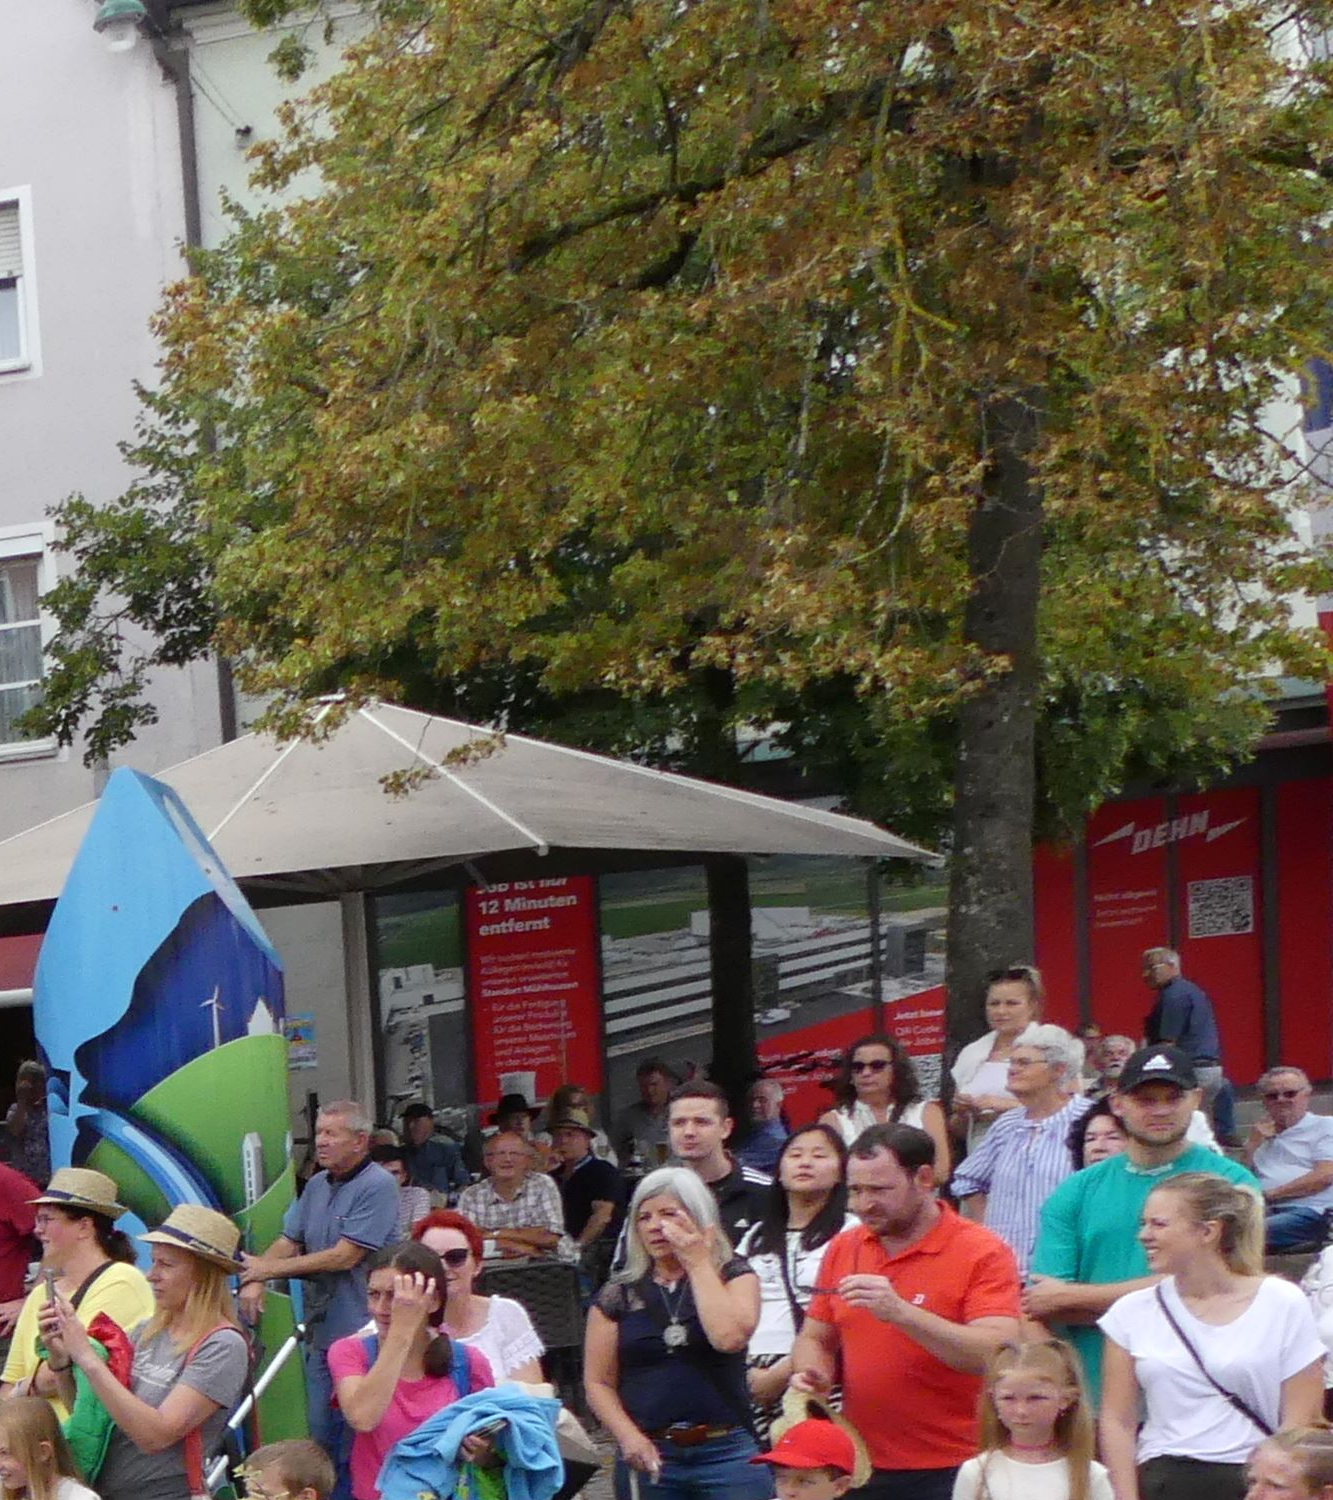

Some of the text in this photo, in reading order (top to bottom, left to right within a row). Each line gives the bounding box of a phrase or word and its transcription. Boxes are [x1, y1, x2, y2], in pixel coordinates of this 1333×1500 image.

[1131, 810, 1210, 855] DEHN
[478, 894, 578, 915] 12 Minuten
[478, 916, 551, 936] entfernt
